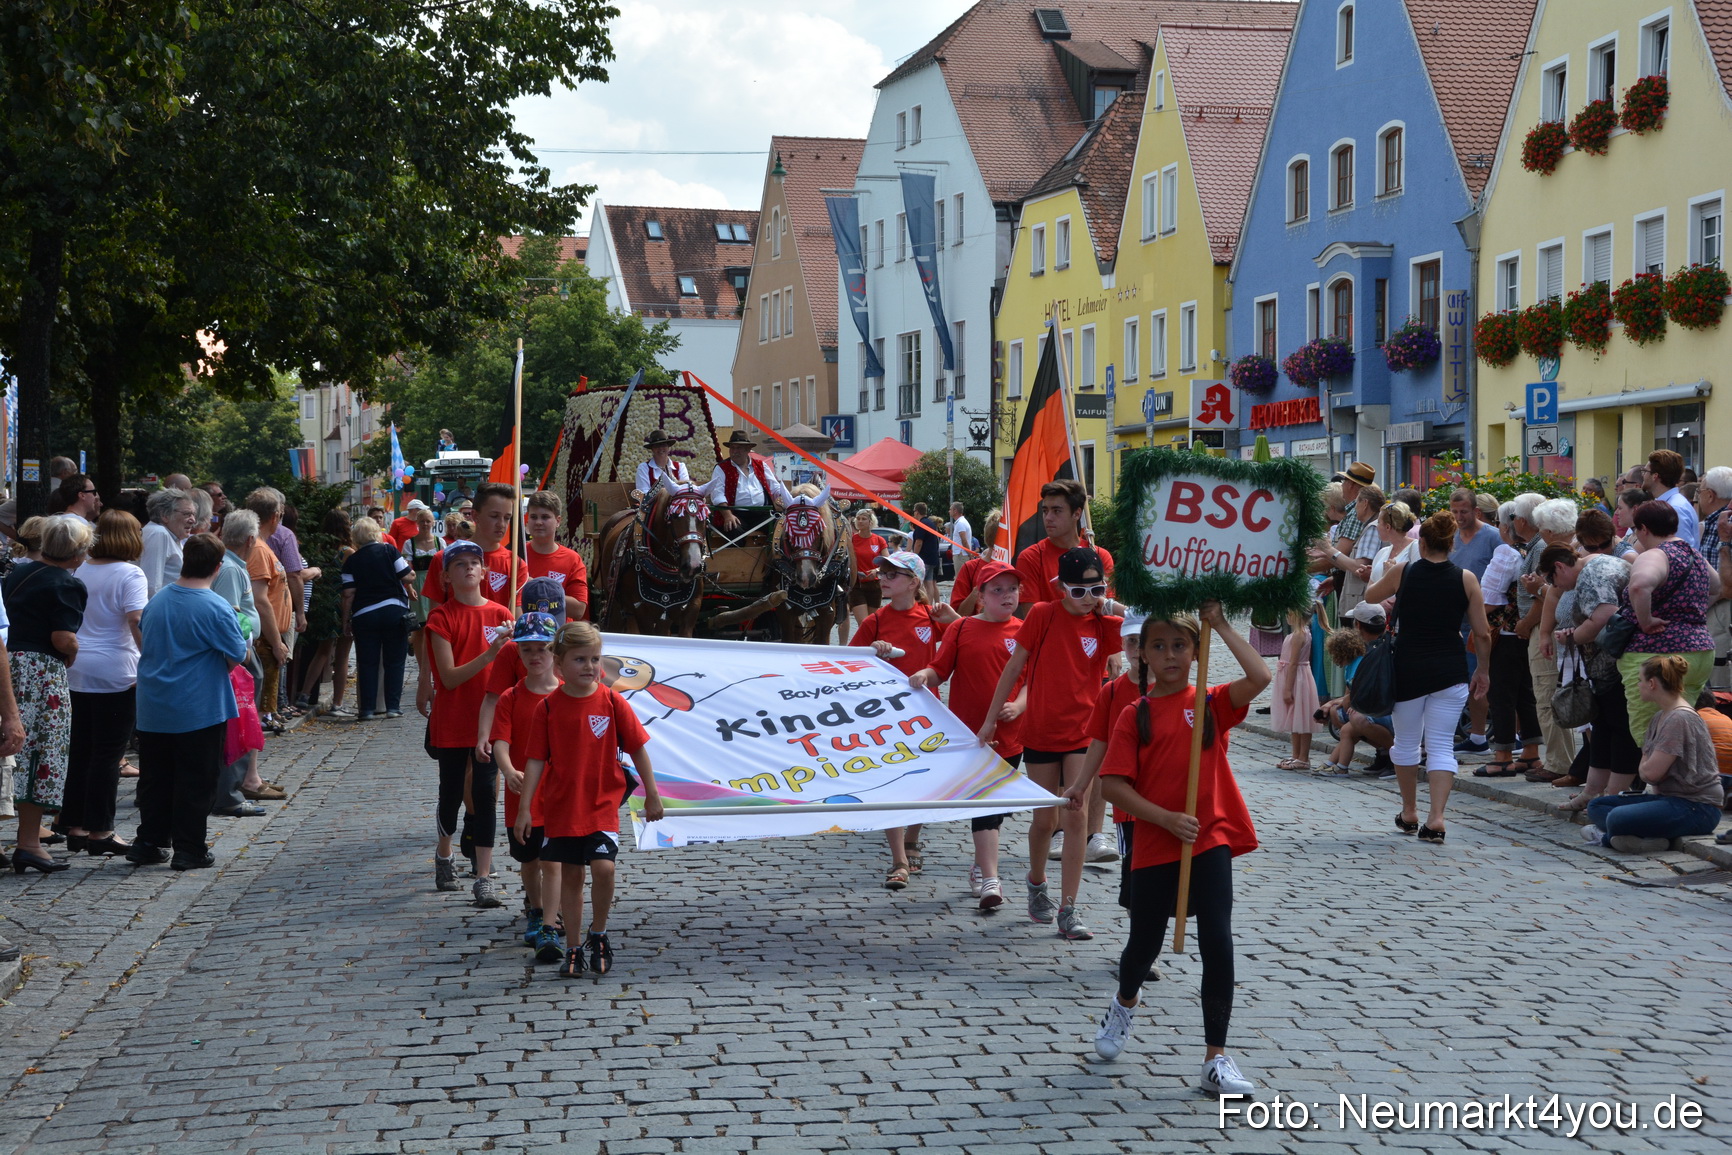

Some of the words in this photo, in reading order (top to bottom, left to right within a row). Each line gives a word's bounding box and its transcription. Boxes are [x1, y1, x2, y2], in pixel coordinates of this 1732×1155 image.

[1448, 312, 1463, 392] WITTL
[1249, 396, 1320, 430] APOTHEKE
[1533, 388, 1551, 420] P
[1164, 480, 1275, 533] BSC
[1141, 534, 1290, 579] Woffenbach
[778, 678, 898, 700] Bayerische
[716, 691, 912, 742] Kinder
[786, 715, 933, 757] Turn
